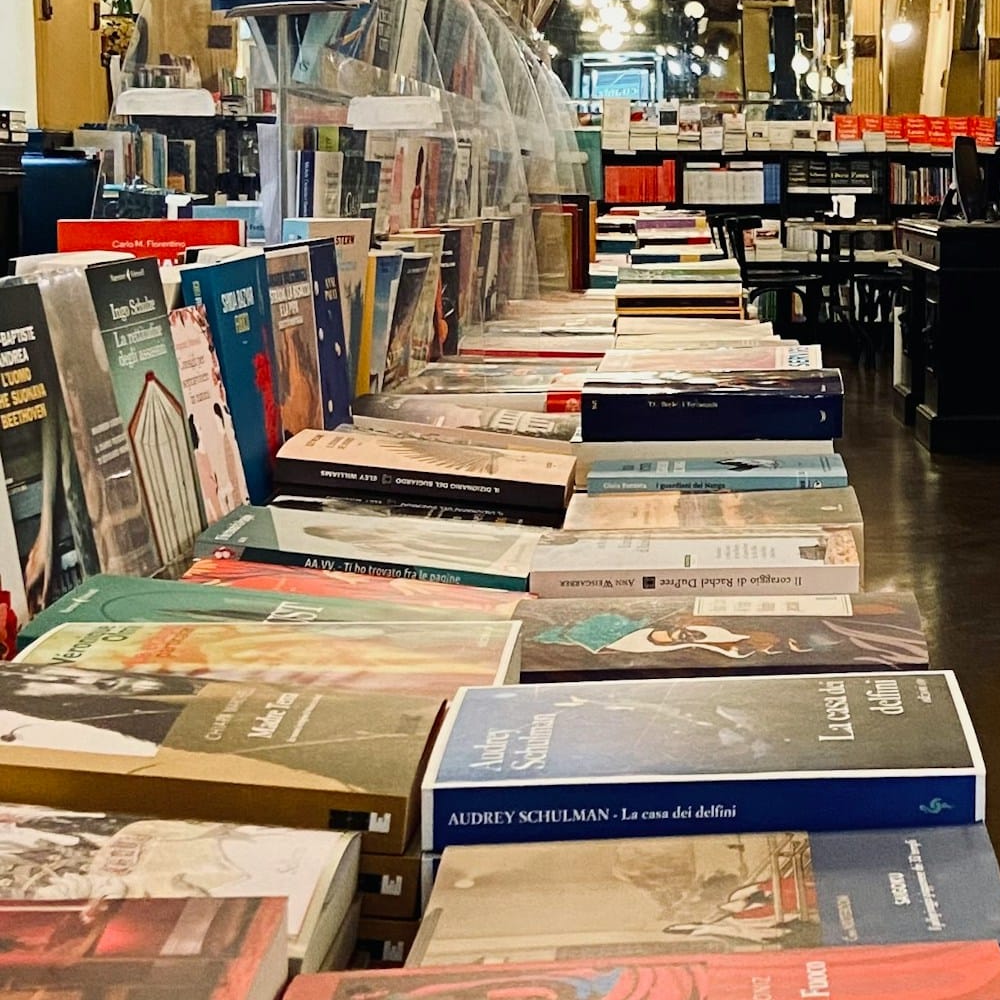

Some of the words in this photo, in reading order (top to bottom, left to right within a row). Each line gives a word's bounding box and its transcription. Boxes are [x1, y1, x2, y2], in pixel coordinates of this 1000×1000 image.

[112, 240, 135, 248] Carlo
[146, 240, 186, 248] Fiorentino
[320, 470, 358, 481] WILLIAMS
[395, 478, 434, 487] BUGIARDO
[435, 481, 449, 489] DEL
[450, 483, 492, 493] DIZIONARIO
[344, 562, 352, 572] Ti
[354, 563, 366, 574] ho
[368, 565, 402, 577] trovato
[404, 568, 417, 579] fra
[419, 570, 428, 580] le
[430, 572, 462, 584] pagine
[659, 578, 697, 588] DuPree
[702, 577, 733, 587] Rachel
[737, 576, 747, 586] di
[750, 574, 791, 585] coraggio
[818, 680, 846, 695] dei
[865, 679, 905, 715] delfini
[824, 695, 851, 721] casa
[818, 722, 855, 741] La
[510, 713, 557, 769] Schulman
[468, 728, 521, 772] Audrey
[448, 811, 515, 826] AUDREY
[518, 808, 610, 824] SCHULMAN
[621, 807, 639, 821] La
[641, 808, 669, 820] casa
[672, 805, 692, 819] dei
[695, 804, 737, 819] delfini
